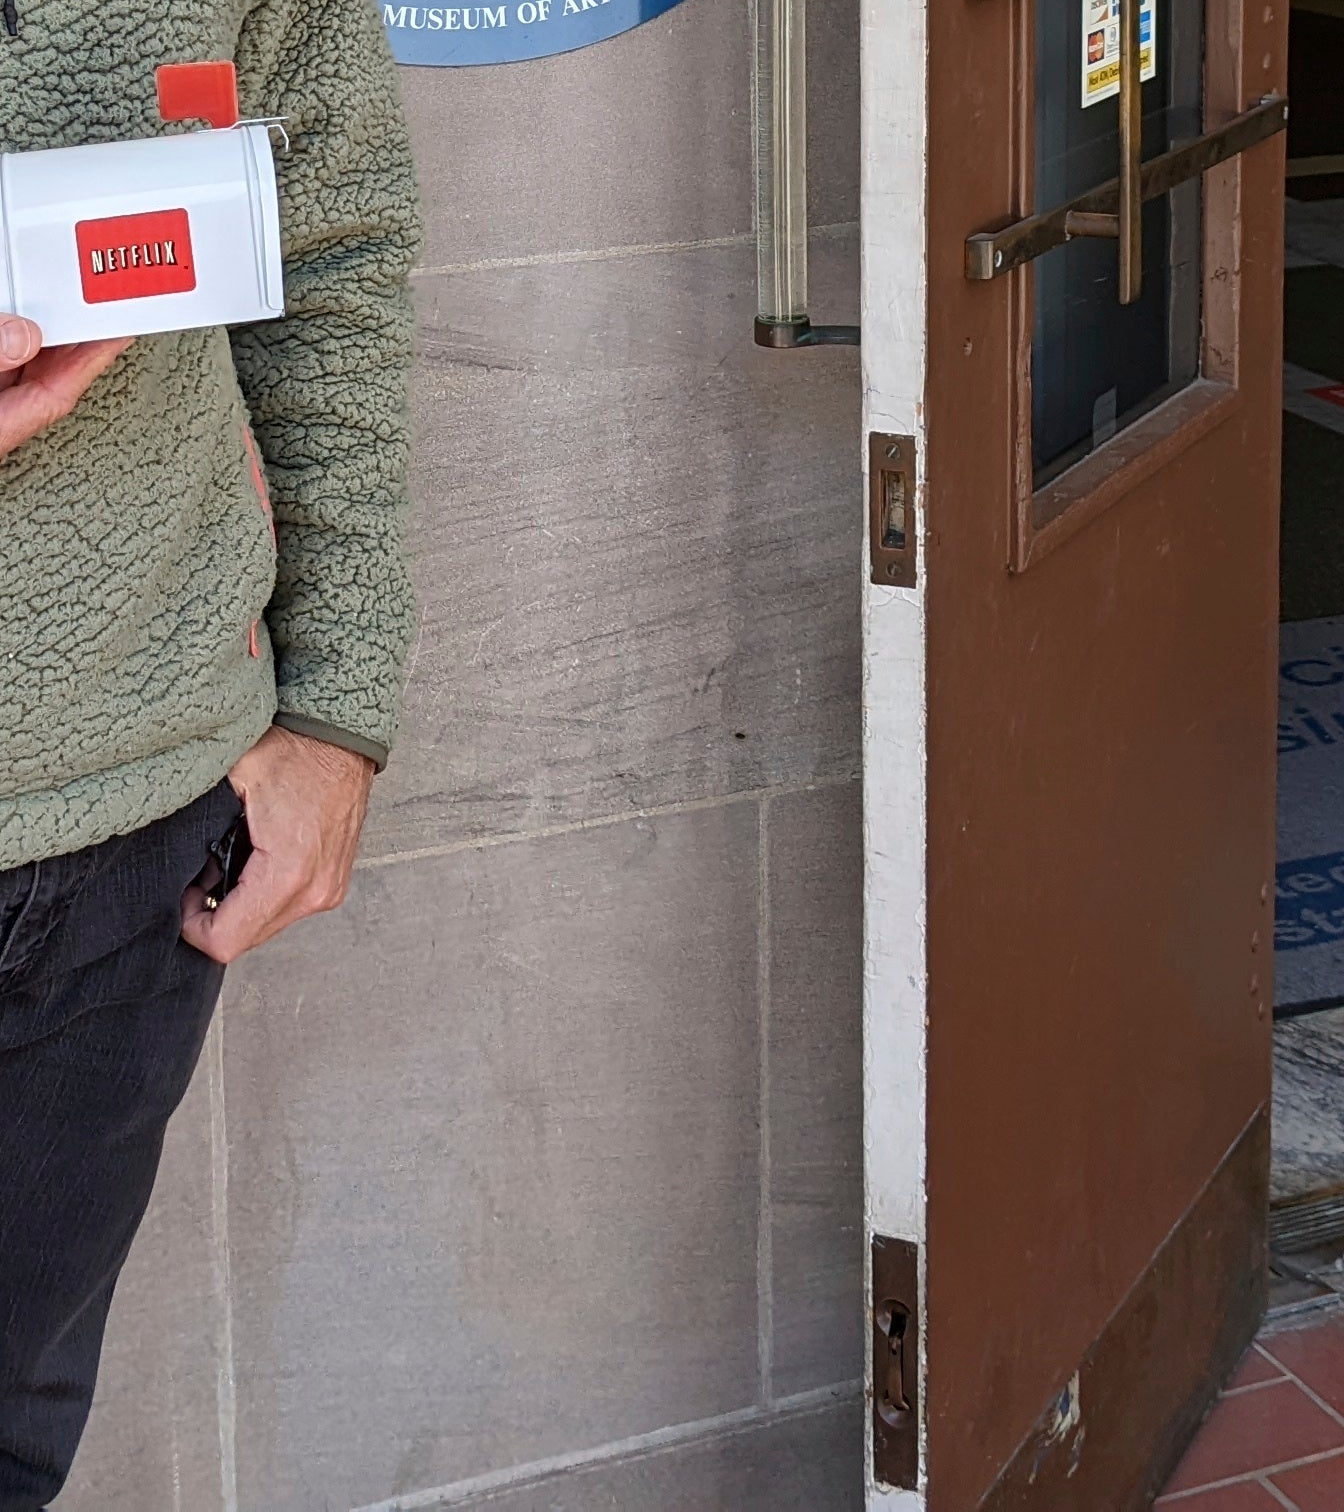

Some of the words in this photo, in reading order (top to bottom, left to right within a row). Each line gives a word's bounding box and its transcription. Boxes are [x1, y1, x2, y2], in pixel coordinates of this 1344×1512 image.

[383, 3, 507, 30] MUSEUM
[517, 0, 552, 24] OF
[92, 241, 178, 275] NETFLIX
